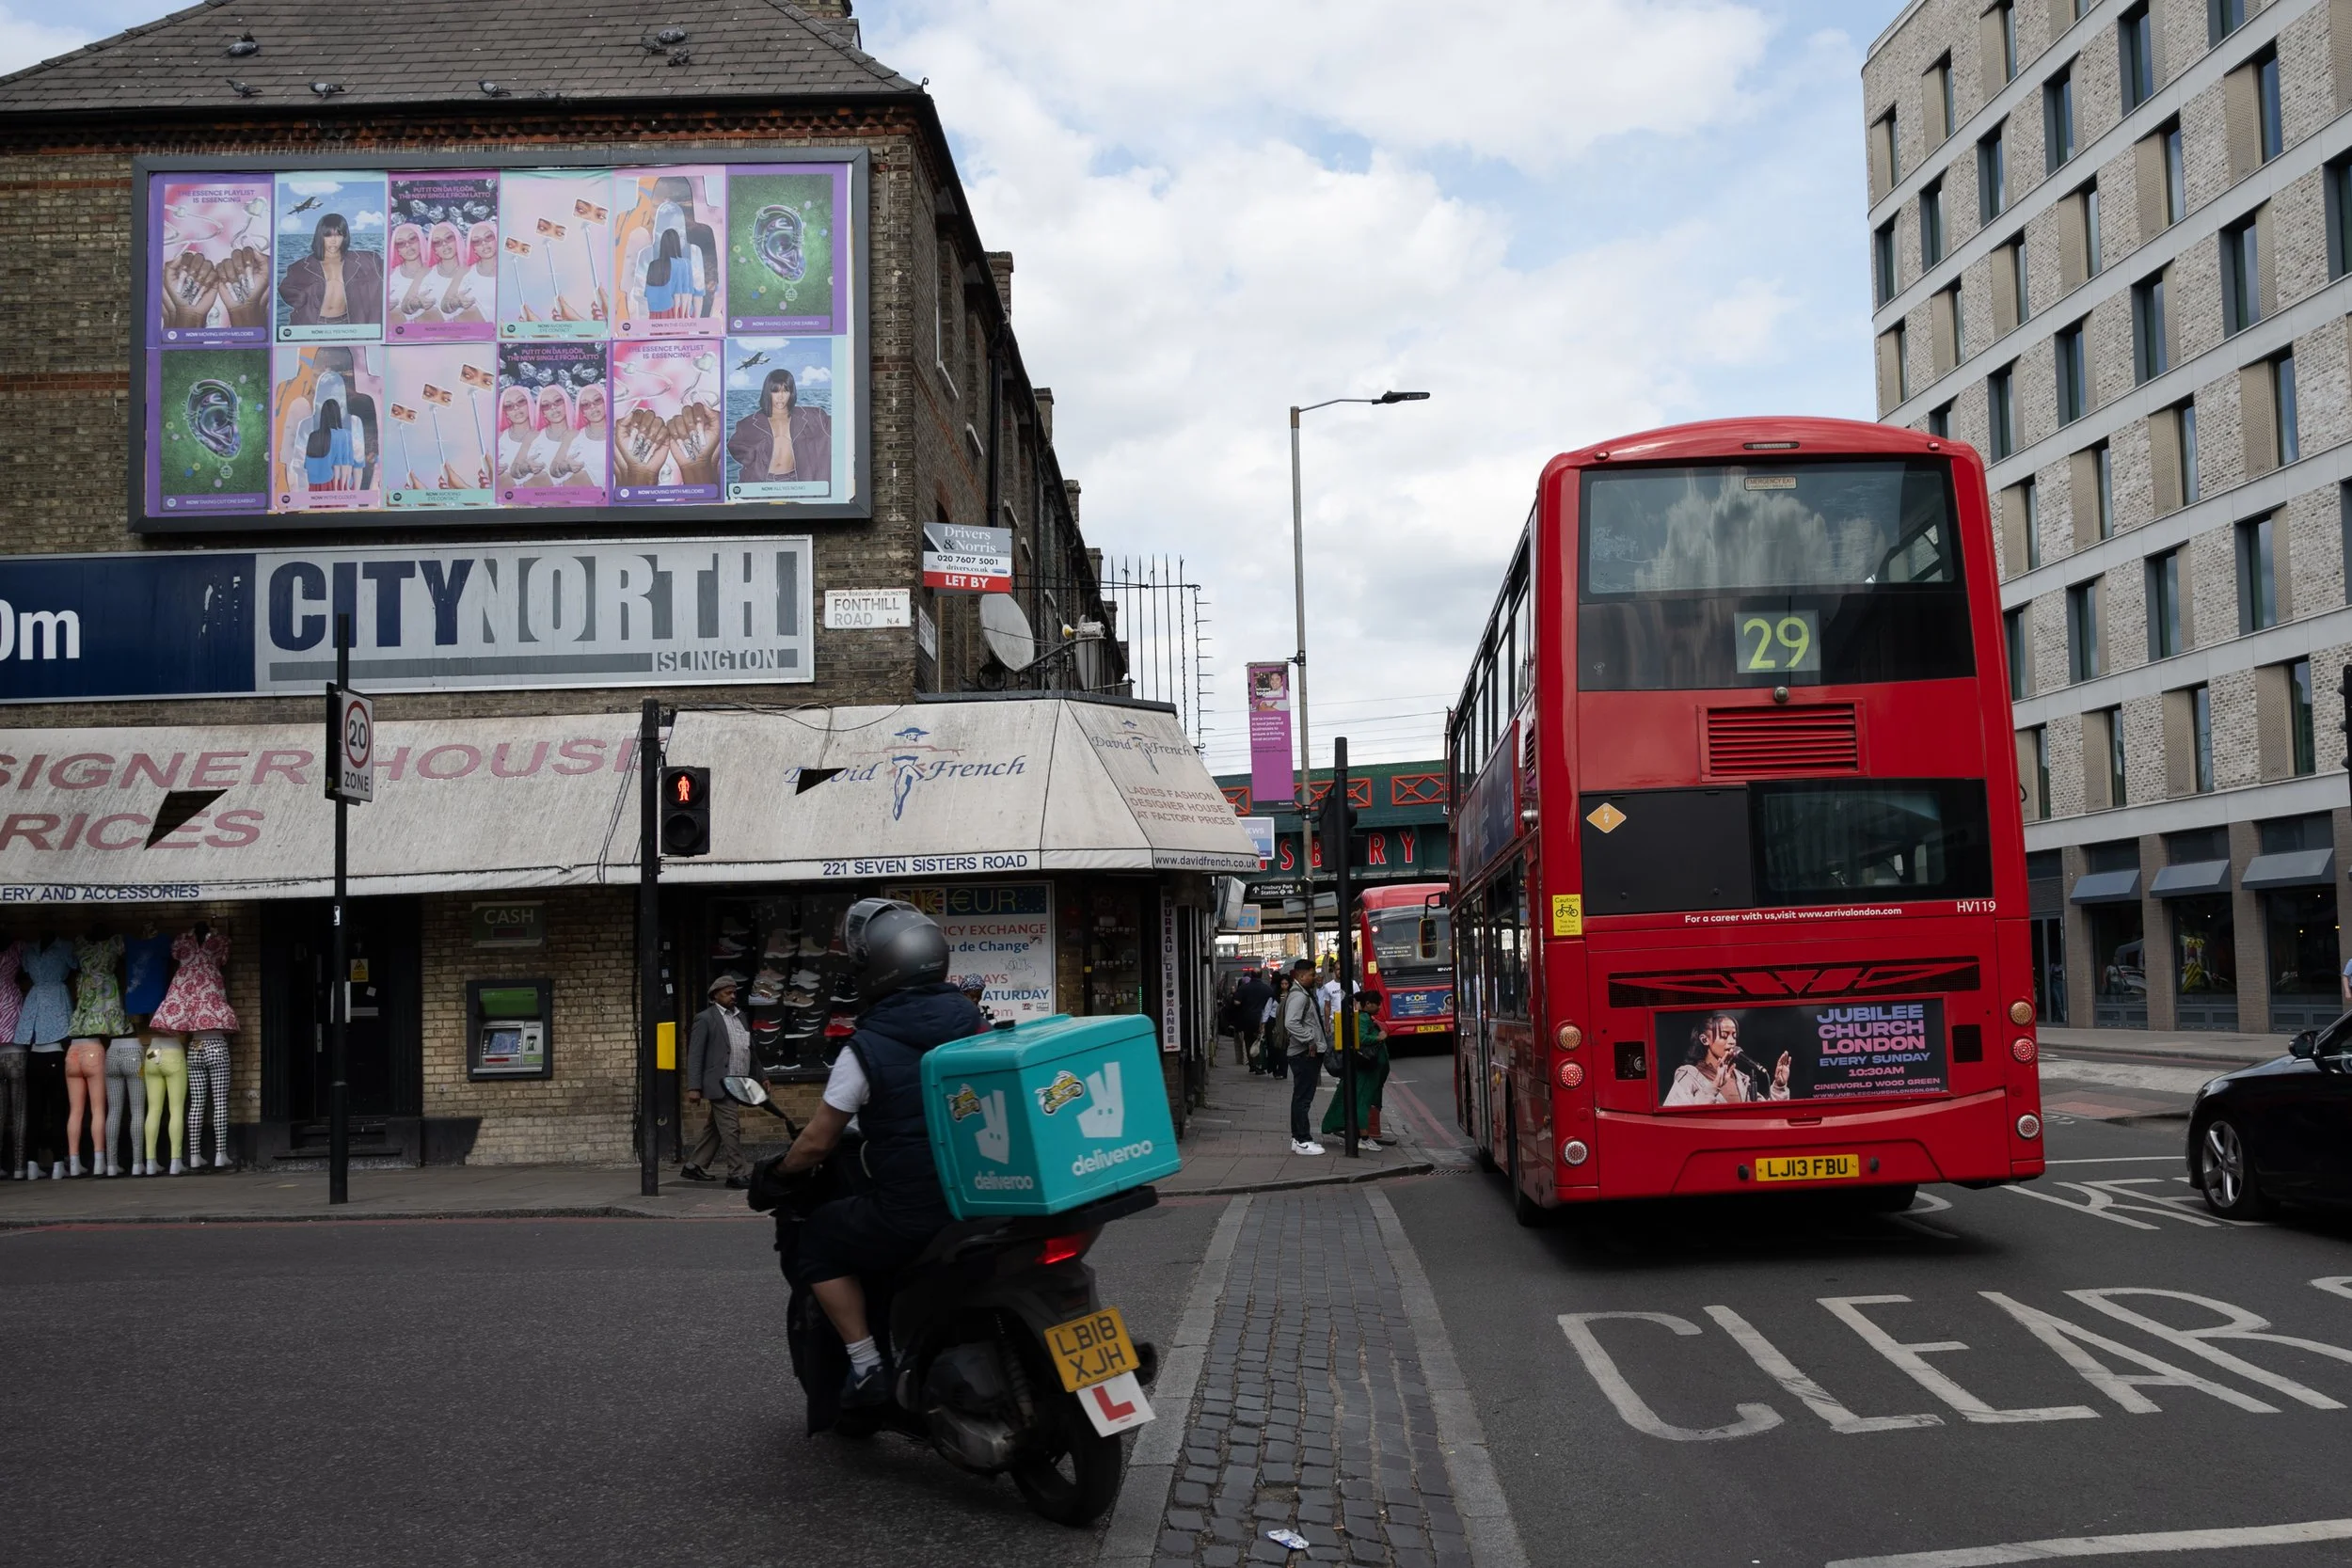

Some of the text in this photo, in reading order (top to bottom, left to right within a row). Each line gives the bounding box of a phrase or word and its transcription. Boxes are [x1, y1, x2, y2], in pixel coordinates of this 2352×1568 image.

[945, 526, 991, 541] Drivers
[944, 539, 996, 553] & Norris
[937, 555, 999, 566] 020 7607 5001
[946, 564, 989, 574] drivers.co.uk
[946, 575, 989, 589] LET BY
[834, 597, 900, 611] FONTHILL
[834, 612, 873, 626] ROAD
[1743, 617, 1809, 669] 29
[652, 649, 779, 672] ISLINGTON
[349, 720, 367, 750] 20
[1092, 736, 1191, 756] David French
[925, 755, 1026, 782] French
[344, 771, 369, 792] ZONE
[1126, 786, 1216, 801] LADIES FASHION
[1131, 798, 1226, 814] DESIGNER HOUSE
[1136, 811, 1236, 826] AT FACTORY PRICES
[823, 854, 1027, 876] 221 SEVEN SISTERS ROAD
[1154, 856, 1257, 869] www.davidfrench.co.uk
[0, 884, 199, 901] ERY AND ACCESSORIES
[1957, 900, 1996, 912] HV119
[484, 909, 534, 925] CASH
[1684, 914, 1700, 924] For
[1742, 912, 1763, 921] with
[1798, 907, 1902, 919] www.arrivalondon.com
[970, 924, 1046, 935] EXCHANGE
[960, 942, 975, 952] de
[978, 941, 1029, 954] Change
[983, 974, 1009, 984] AYS
[983, 990, 1049, 1001] ATURDAY
[1817, 1005, 1923, 1023] JUBILEE
[1818, 1020, 1925, 1038] CHURCH
[1822, 1036, 1925, 1054] LONDON
[1820, 1052, 1931, 1067] EVERY SUNDAY
[1848, 1067, 1904, 1076] 10:30AM
[1814, 1082, 1872, 1091] CINEWORLD
[1072, 1140, 1153, 1176] deliveroo
[1767, 1158, 1848, 1178] LJ13 FBU
[975, 1171, 1033, 1190] deliveroo
[1055, 1316, 1118, 1356] LB18
[1069, 1343, 1126, 1383] XJH
[1557, 1288, 2352, 1442] CLEAR
[1091, 1386, 1136, 1422] L
